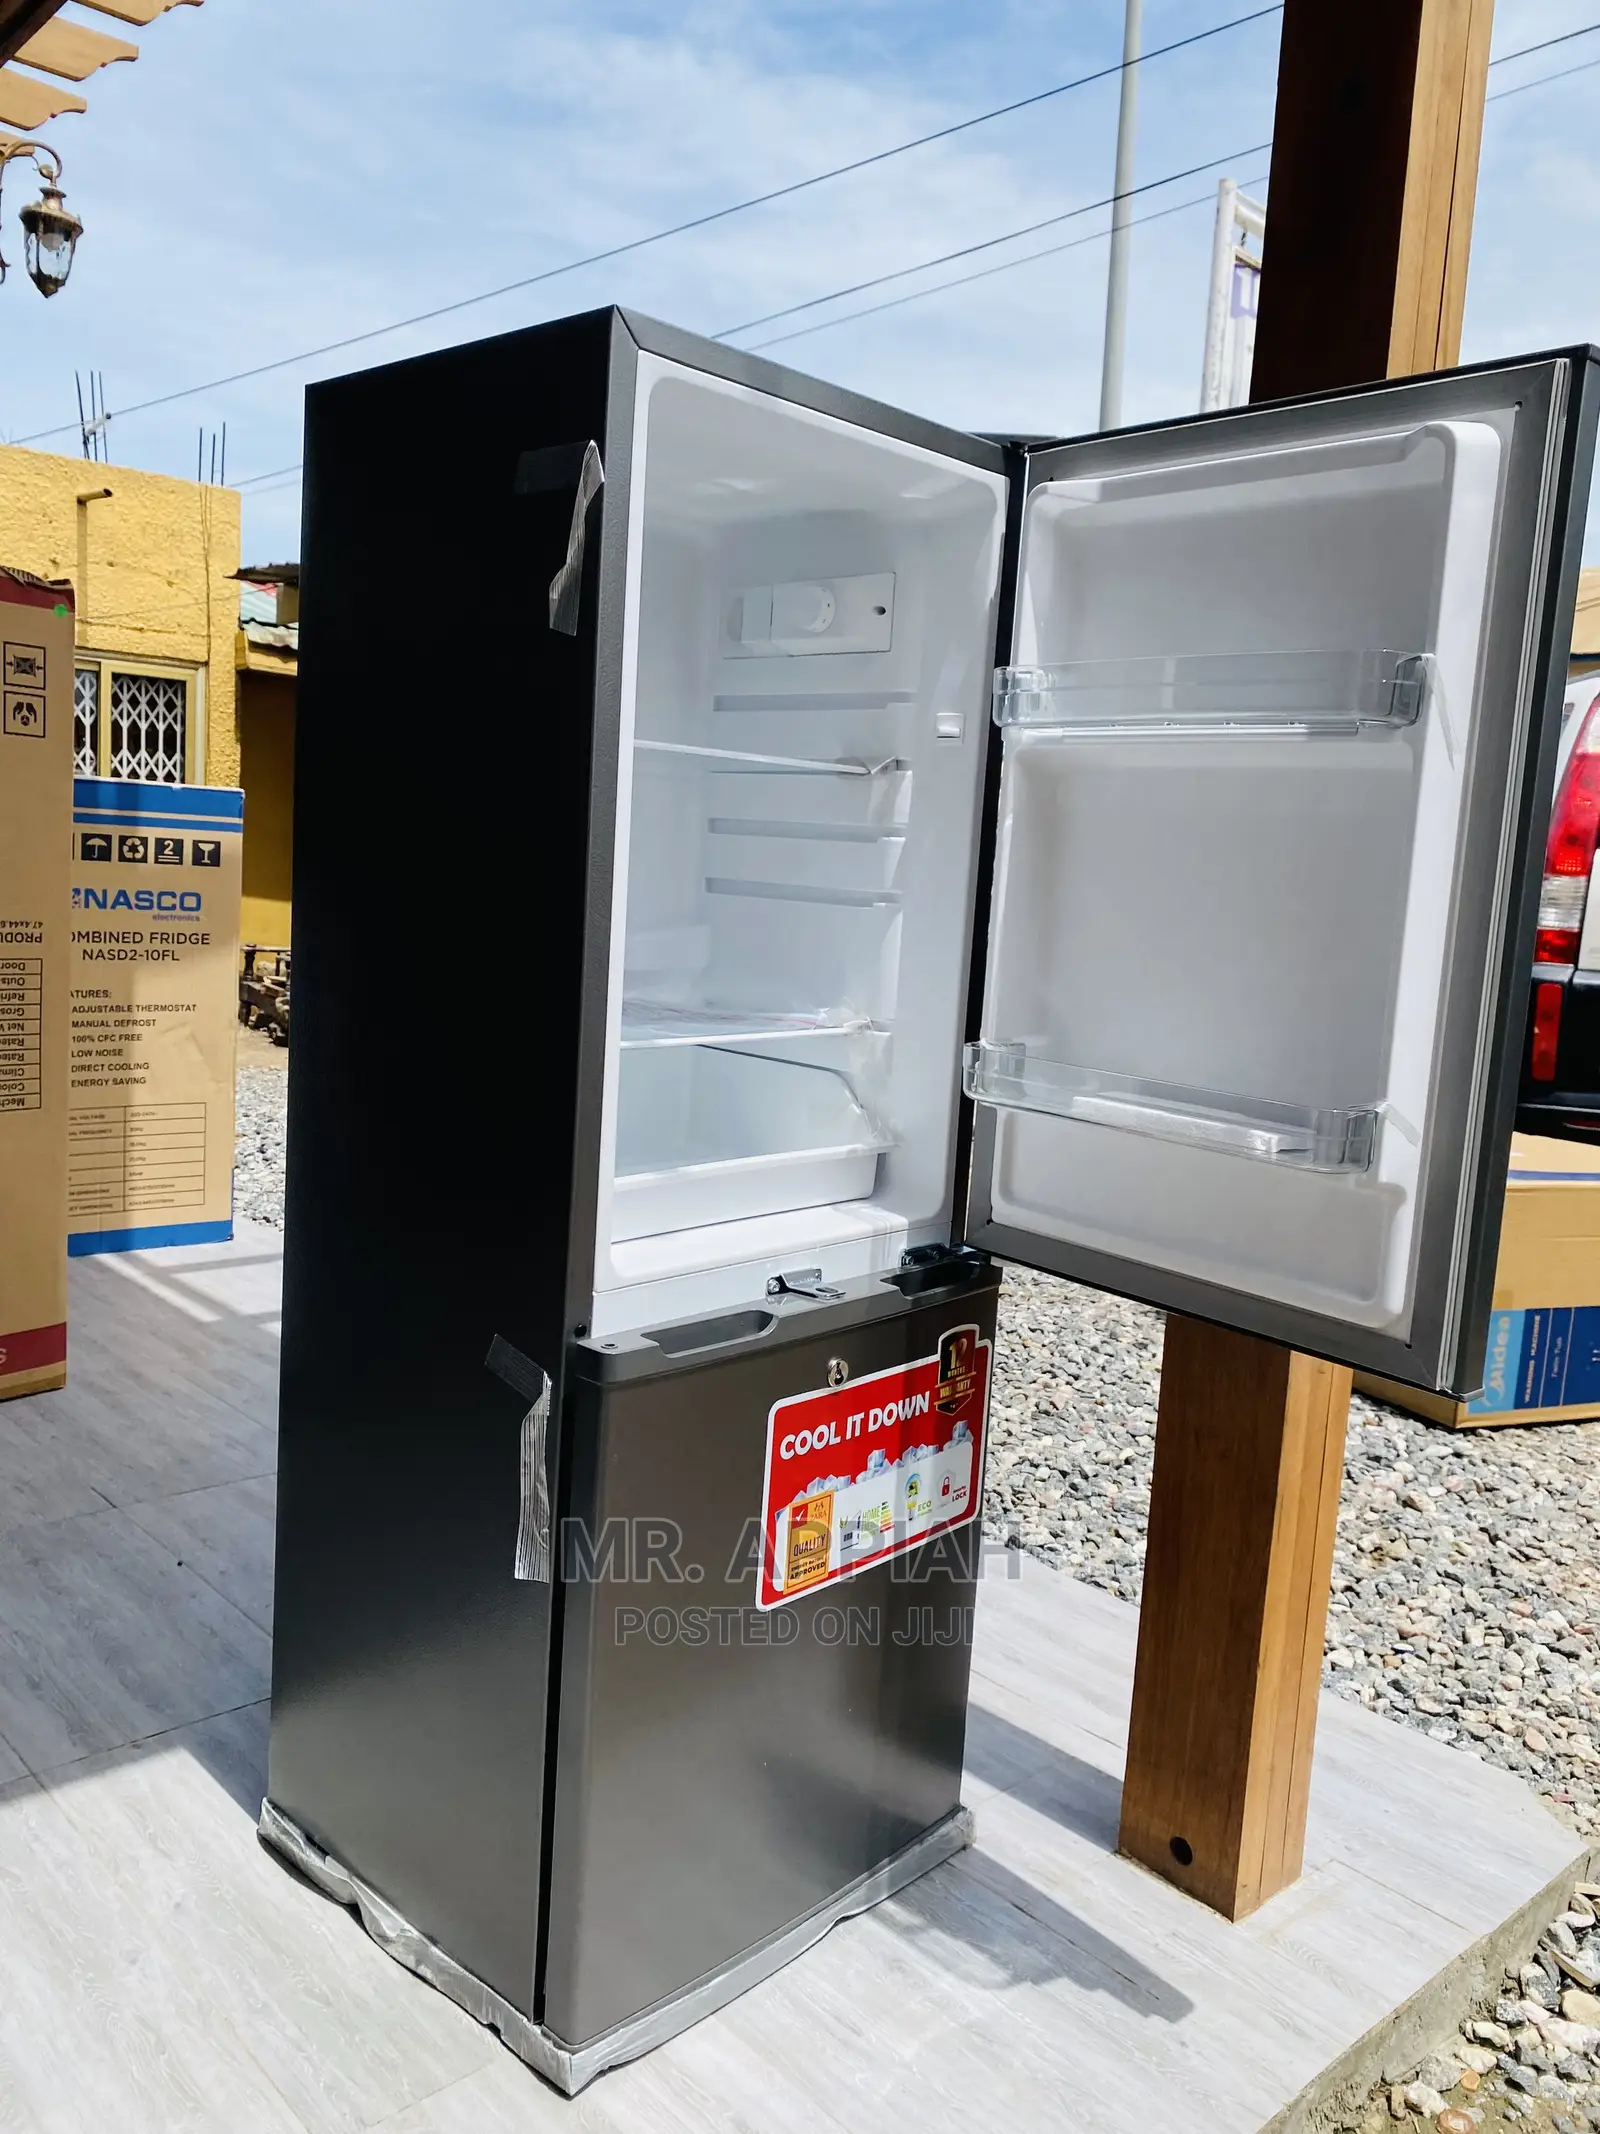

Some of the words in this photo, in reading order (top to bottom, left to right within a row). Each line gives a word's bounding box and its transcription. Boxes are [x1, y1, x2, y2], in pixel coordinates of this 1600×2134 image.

[83, 888, 202, 912] NASCO
[152, 913, 200, 922] electronics
[149, 932, 210, 945] FRIDGE
[82, 948, 180, 961] NASD2-10FL
[71, 1004, 133, 1014] ADJUSTABLE
[136, 1004, 197, 1012] THERMOSTAT
[71, 1020, 111, 1028] MANUAL
[114, 1019, 157, 1028] DEFROST
[72, 1034, 95, 1043] 100%
[97, 1034, 116, 1042] CFC
[119, 1033, 143, 1042] FREE
[71, 1049, 93, 1058] LOW
[95, 1048, 123, 1057] NOISE
[71, 1063, 105, 1073] DIRECT
[107, 1062, 150, 1072] COOLING
[0, 1082, 25, 1092] Colo
[71, 1078, 109, 1088] ENERGY
[111, 1076, 147, 1086] SAVING
[1530, 1315, 1541, 1356] MACHINE
[779, 1421, 841, 1460] COOL
[846, 1412, 865, 1440] IT
[868, 1391, 930, 1433] DOWN
[951, 1490, 967, 1502] LOCK
[917, 1500, 932, 1512] ECO
[793, 1534, 826, 1557] QUALITY
[790, 1561, 826, 1580] APPROVED
